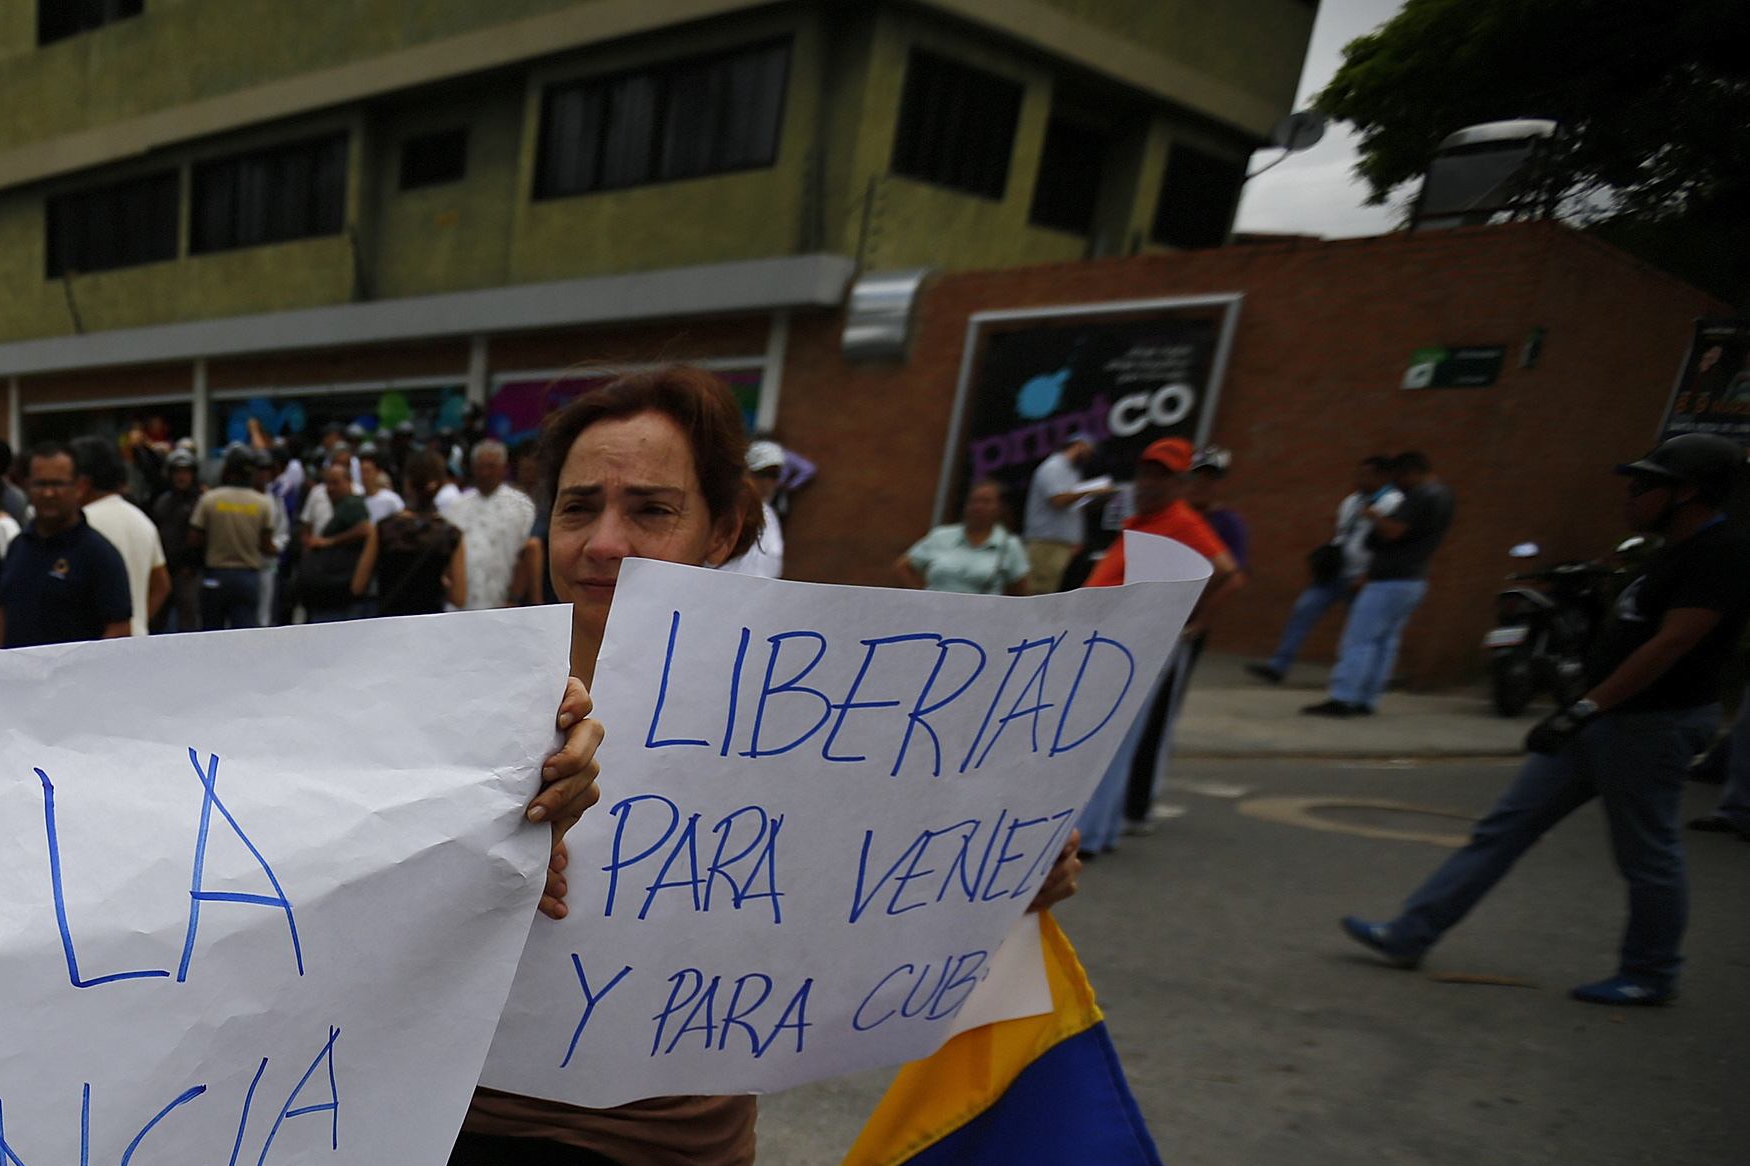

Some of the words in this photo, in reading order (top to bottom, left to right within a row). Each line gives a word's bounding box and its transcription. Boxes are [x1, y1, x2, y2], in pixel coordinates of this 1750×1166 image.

[645, 610, 1136, 777] LIBERTAD
[34, 745, 305, 989] LA
[602, 793, 785, 925] PARA
[849, 808, 1074, 924] VENEZ
[561, 953, 633, 1068] Y
[652, 967, 813, 1058] PARA
[852, 938, 1005, 1031] CUB
